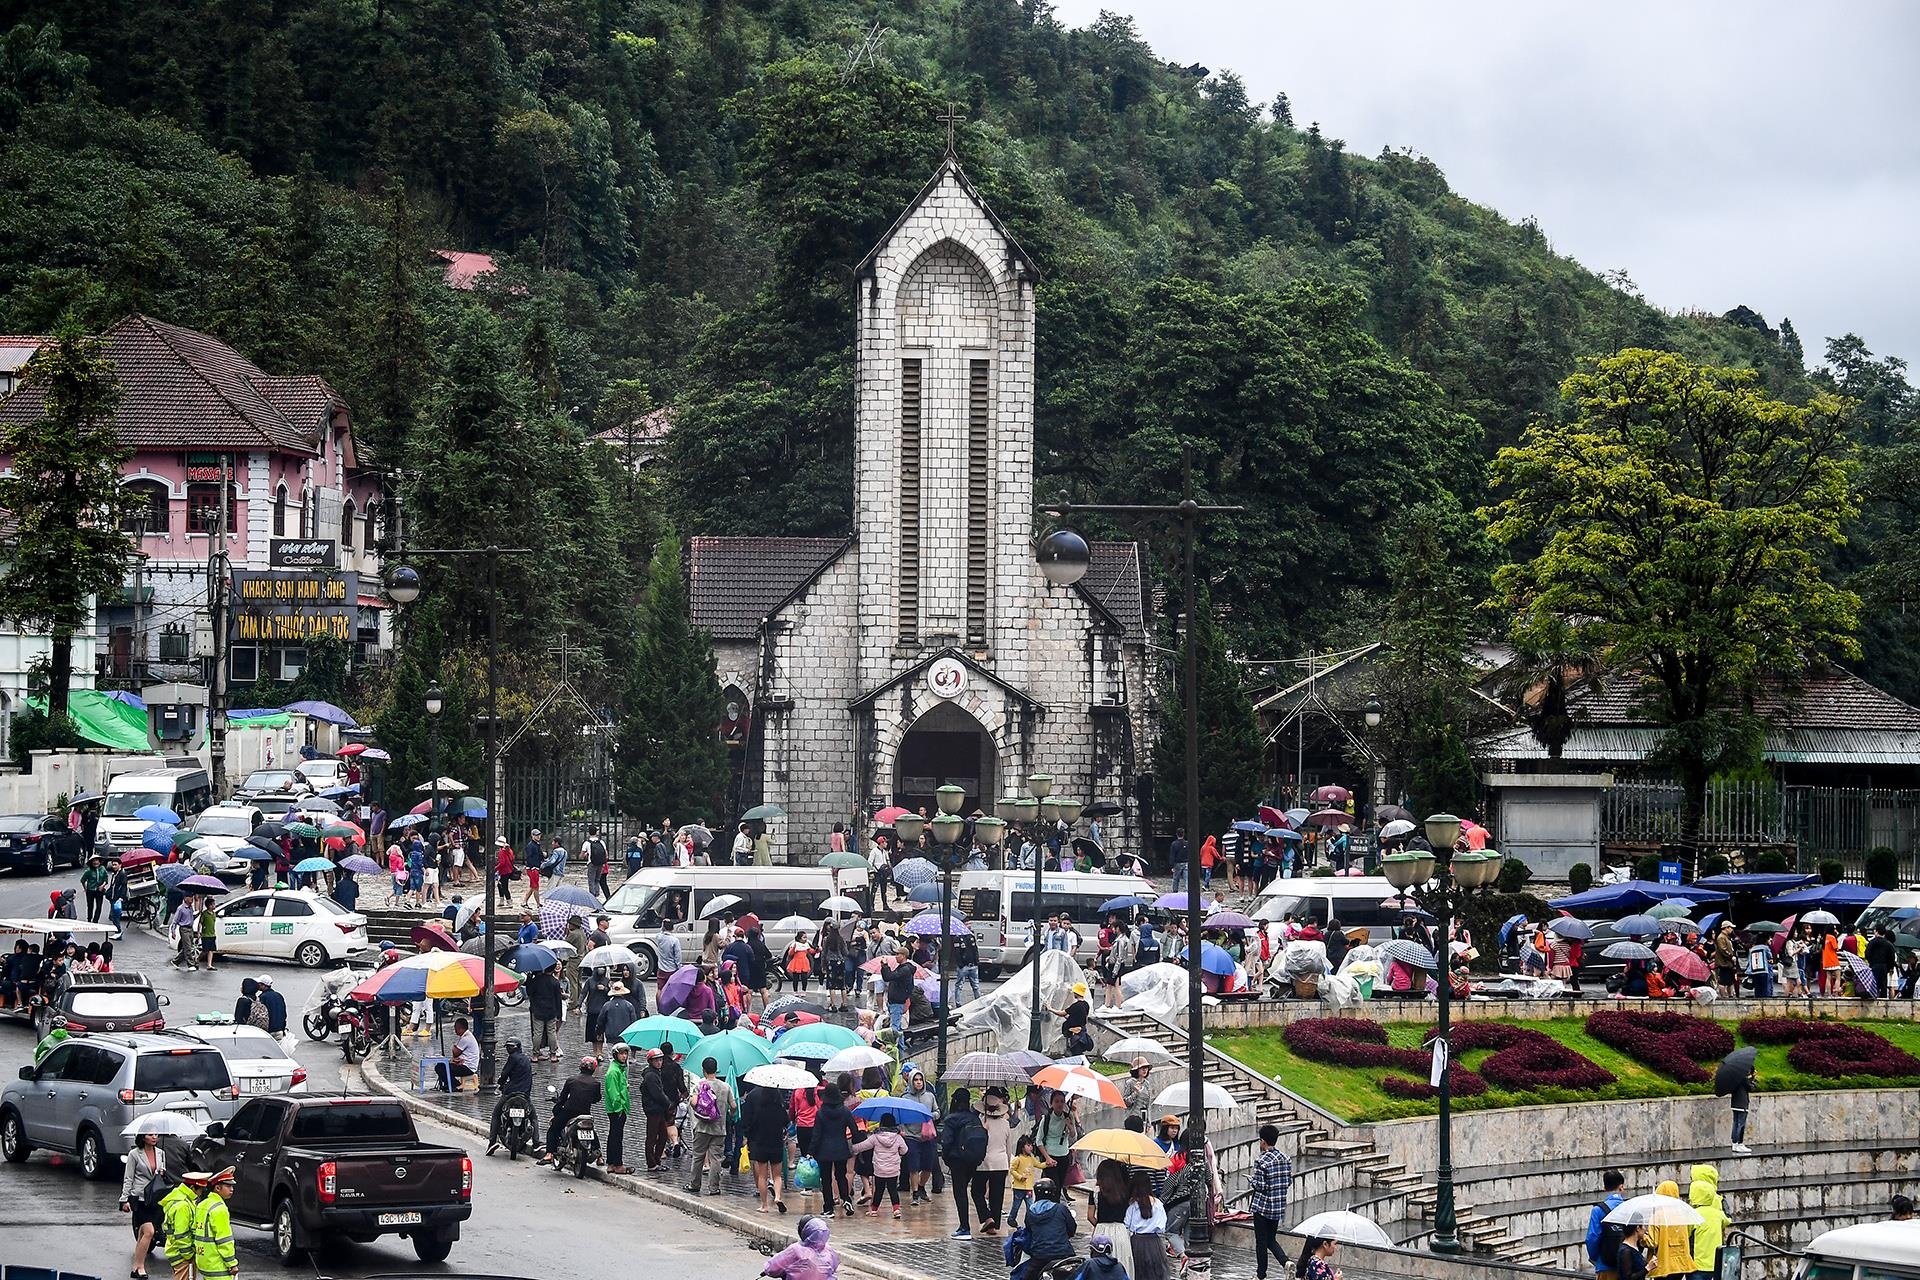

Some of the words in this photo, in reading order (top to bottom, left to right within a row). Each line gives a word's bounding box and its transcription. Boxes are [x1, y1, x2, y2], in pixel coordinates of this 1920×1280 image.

[188, 467, 233, 481] MASSAE
[282, 555, 323, 565] Coffee
[242, 576, 273, 599] KHÁCH
[275, 580, 294, 602] SẠN
[261, 609, 273, 639] LÁ
[275, 606, 305, 639] THUỐC
